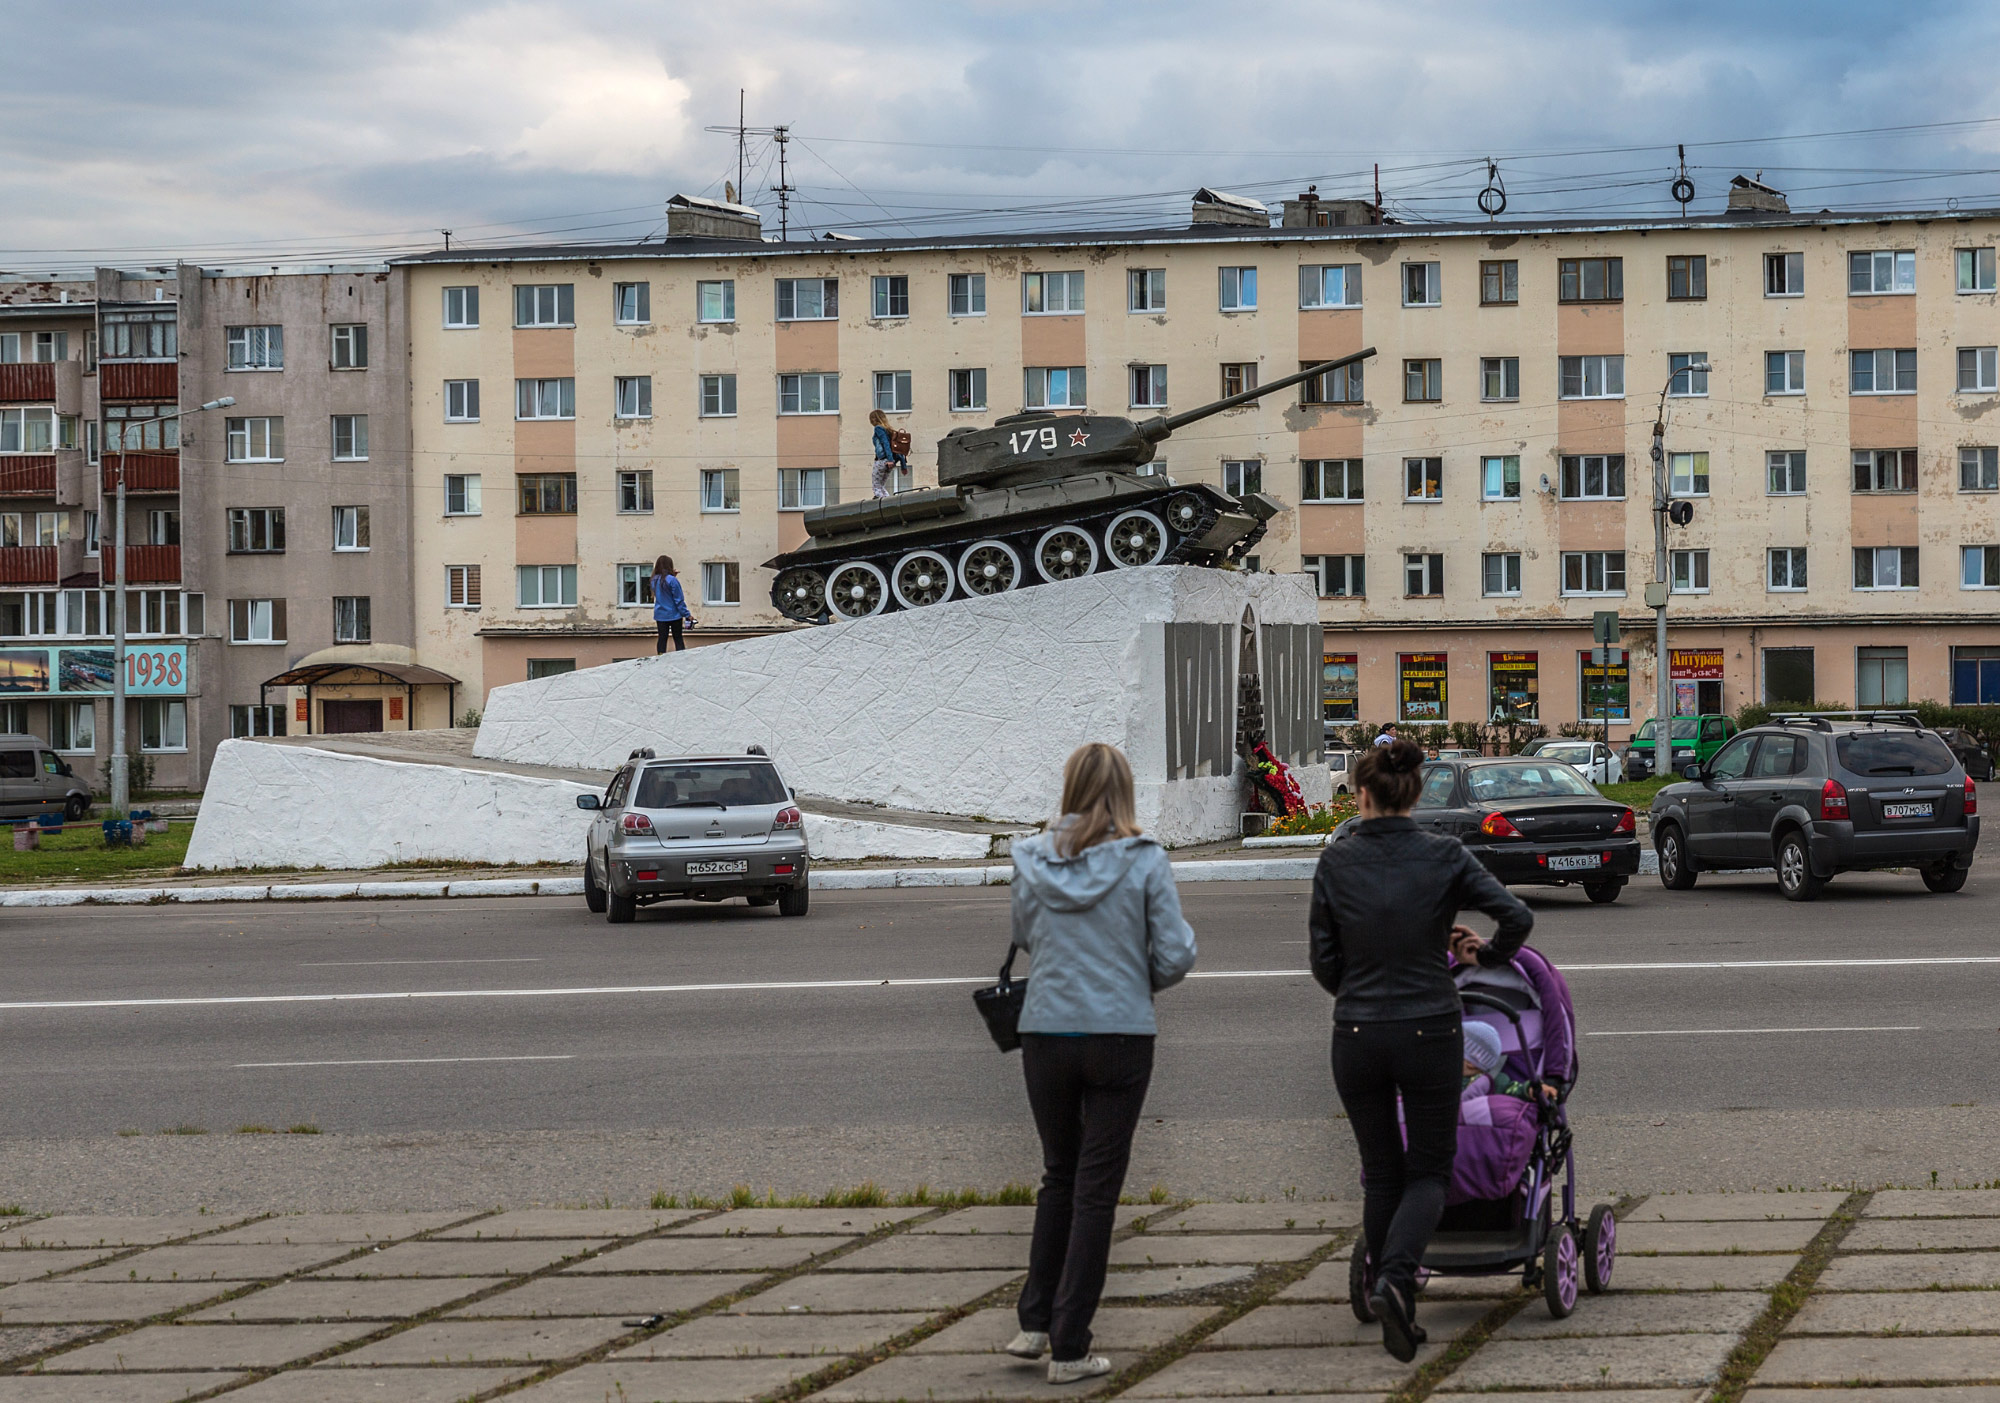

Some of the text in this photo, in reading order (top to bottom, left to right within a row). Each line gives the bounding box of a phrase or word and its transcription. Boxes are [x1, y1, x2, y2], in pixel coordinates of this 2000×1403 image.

[1009, 427, 1057, 454] 179
[127, 652, 182, 686] 1938
[1671, 651, 1724, 668] Антураж
[690, 861, 744, 873] М652КС 51
